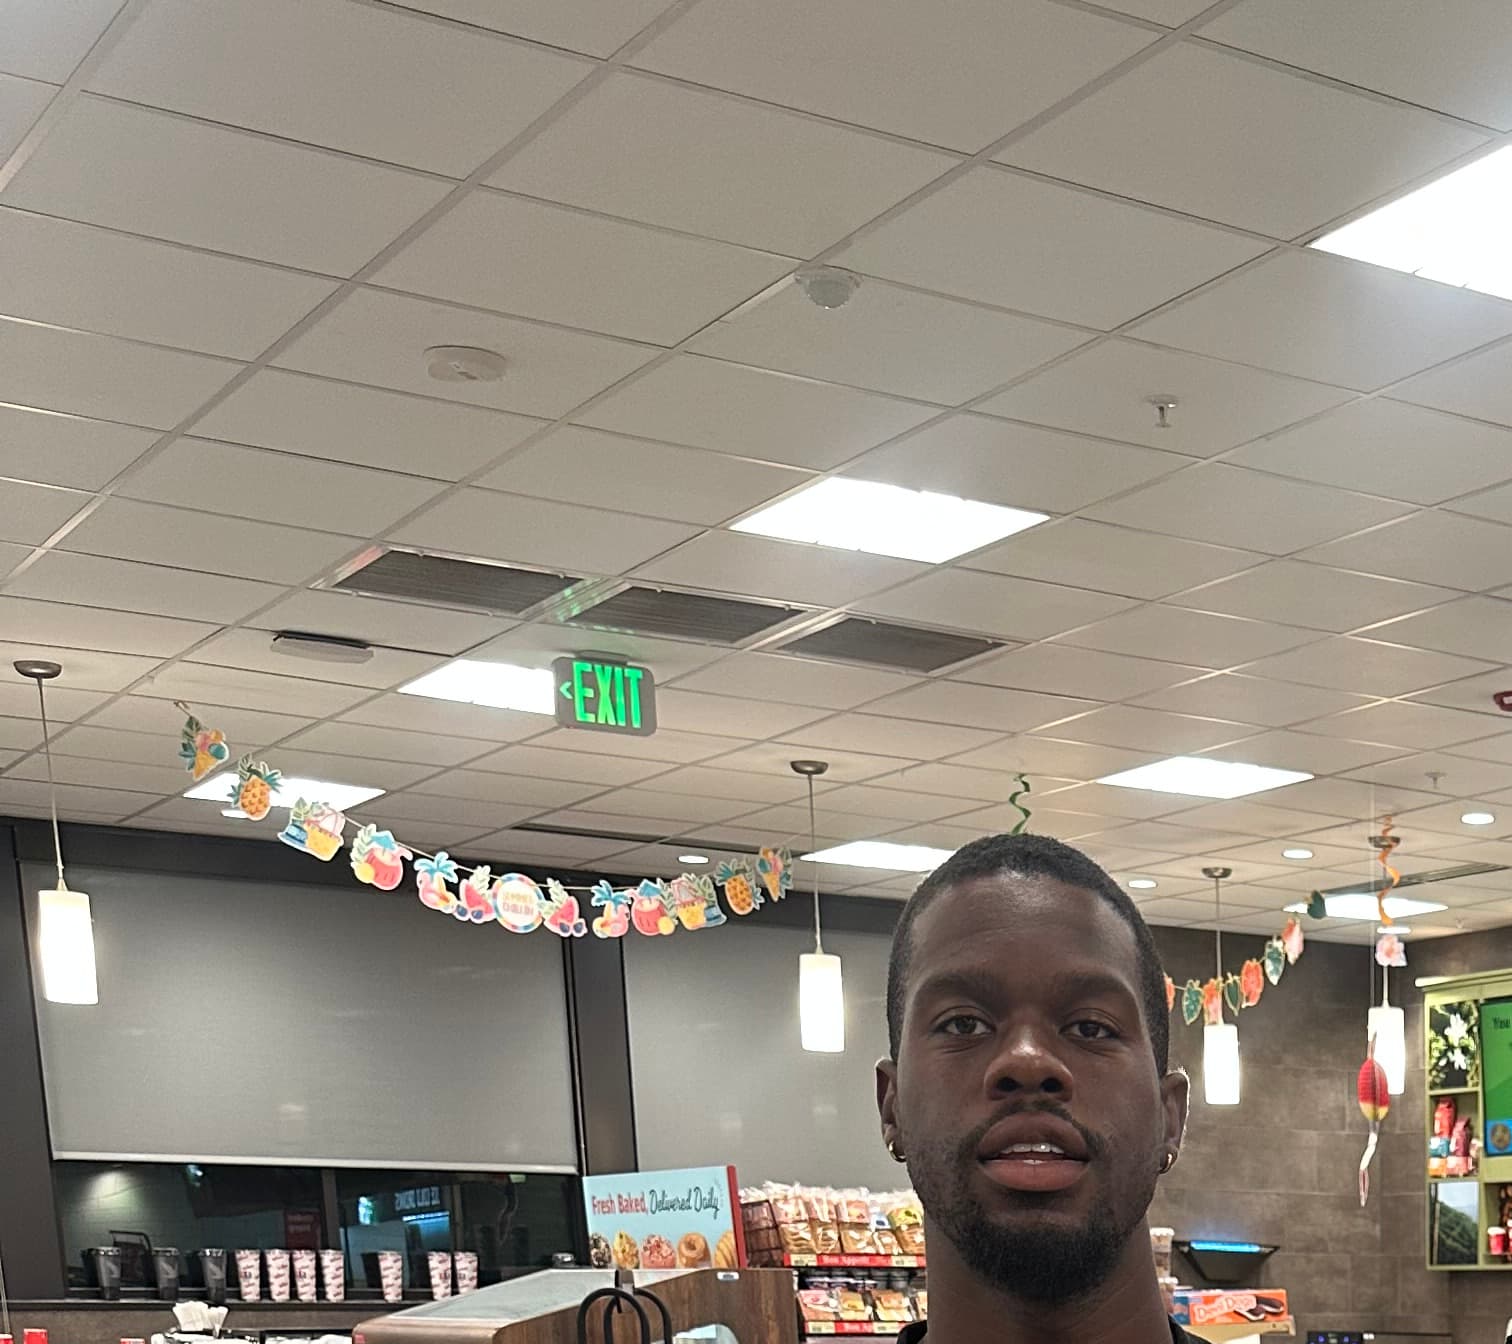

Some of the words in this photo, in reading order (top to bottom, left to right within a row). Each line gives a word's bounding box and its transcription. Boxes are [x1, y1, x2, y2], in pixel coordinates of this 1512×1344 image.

[572, 661, 643, 728] EXIT
[1493, 1016, 1511, 1029] You
[592, 1193, 617, 1215] Fresh
[649, 1187, 692, 1215] Delivered
[693, 1185, 720, 1220] Daily
